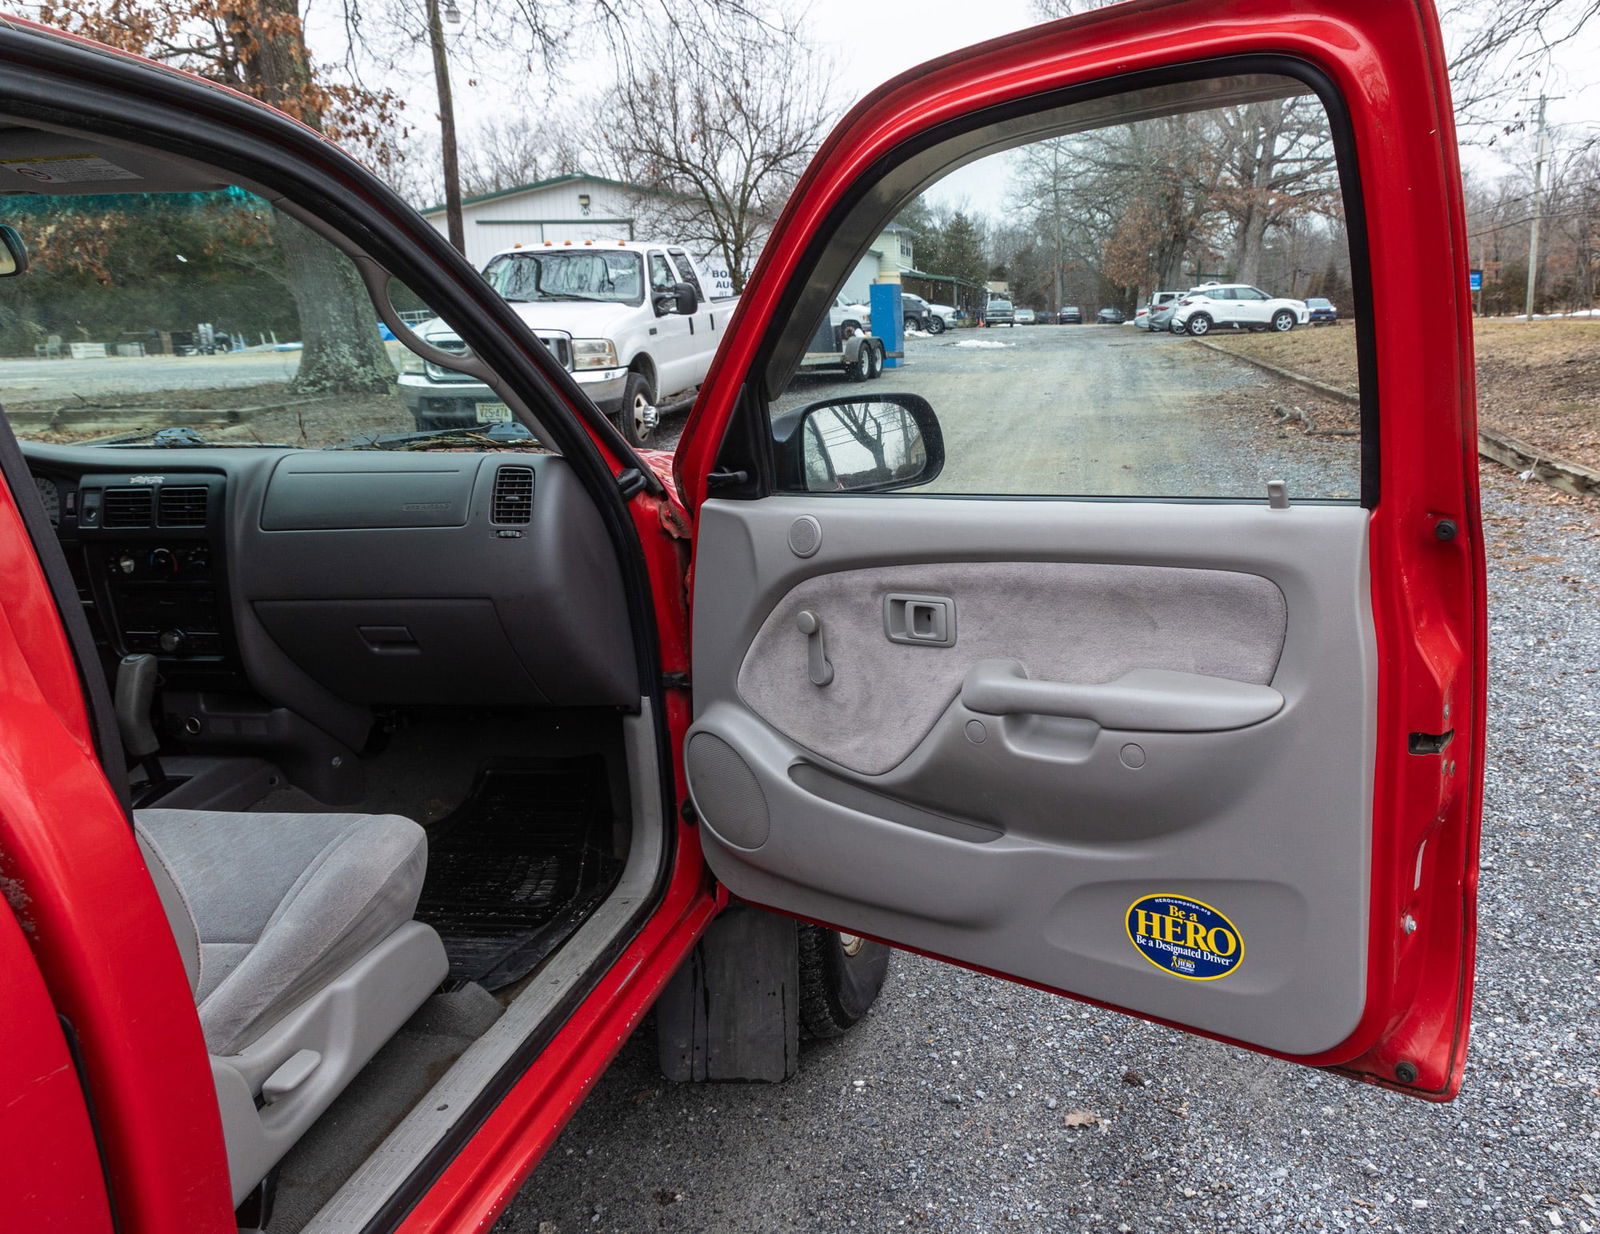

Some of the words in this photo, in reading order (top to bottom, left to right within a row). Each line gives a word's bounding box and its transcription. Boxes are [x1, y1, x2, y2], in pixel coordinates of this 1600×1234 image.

[712, 270, 729, 278] BO
[1169, 905, 1186, 919] Be
[1189, 912, 1198, 922] a
[1135, 909, 1237, 957] HERO
[1136, 934, 1147, 945] Be
[1155, 939, 1201, 959] Designated
